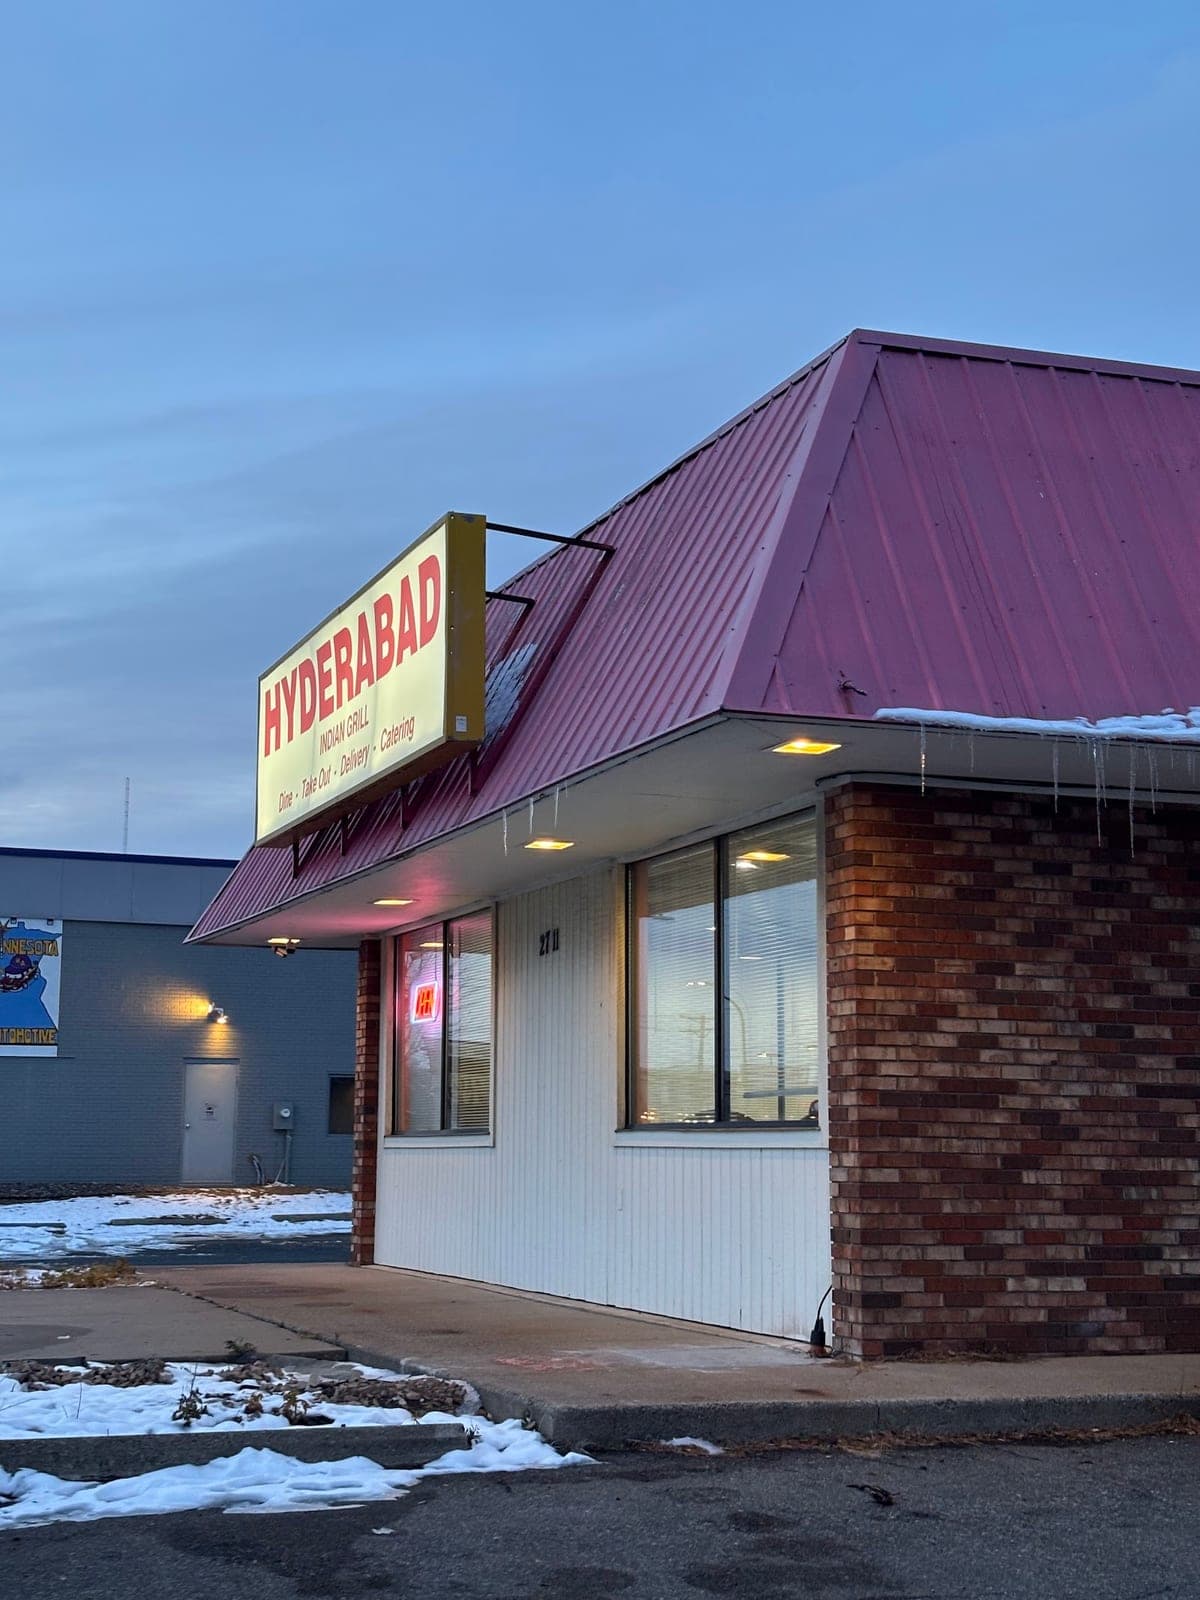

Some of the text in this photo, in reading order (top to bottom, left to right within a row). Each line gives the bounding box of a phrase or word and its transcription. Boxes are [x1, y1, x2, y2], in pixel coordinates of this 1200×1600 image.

[264, 554, 441, 756] HYDERABAD
[279, 716, 415, 813] Dine Take Out Delivery Catering
[319, 704, 369, 756] INDIAN GRILL
[0, 1028, 57, 1044] TOMOTIVE
